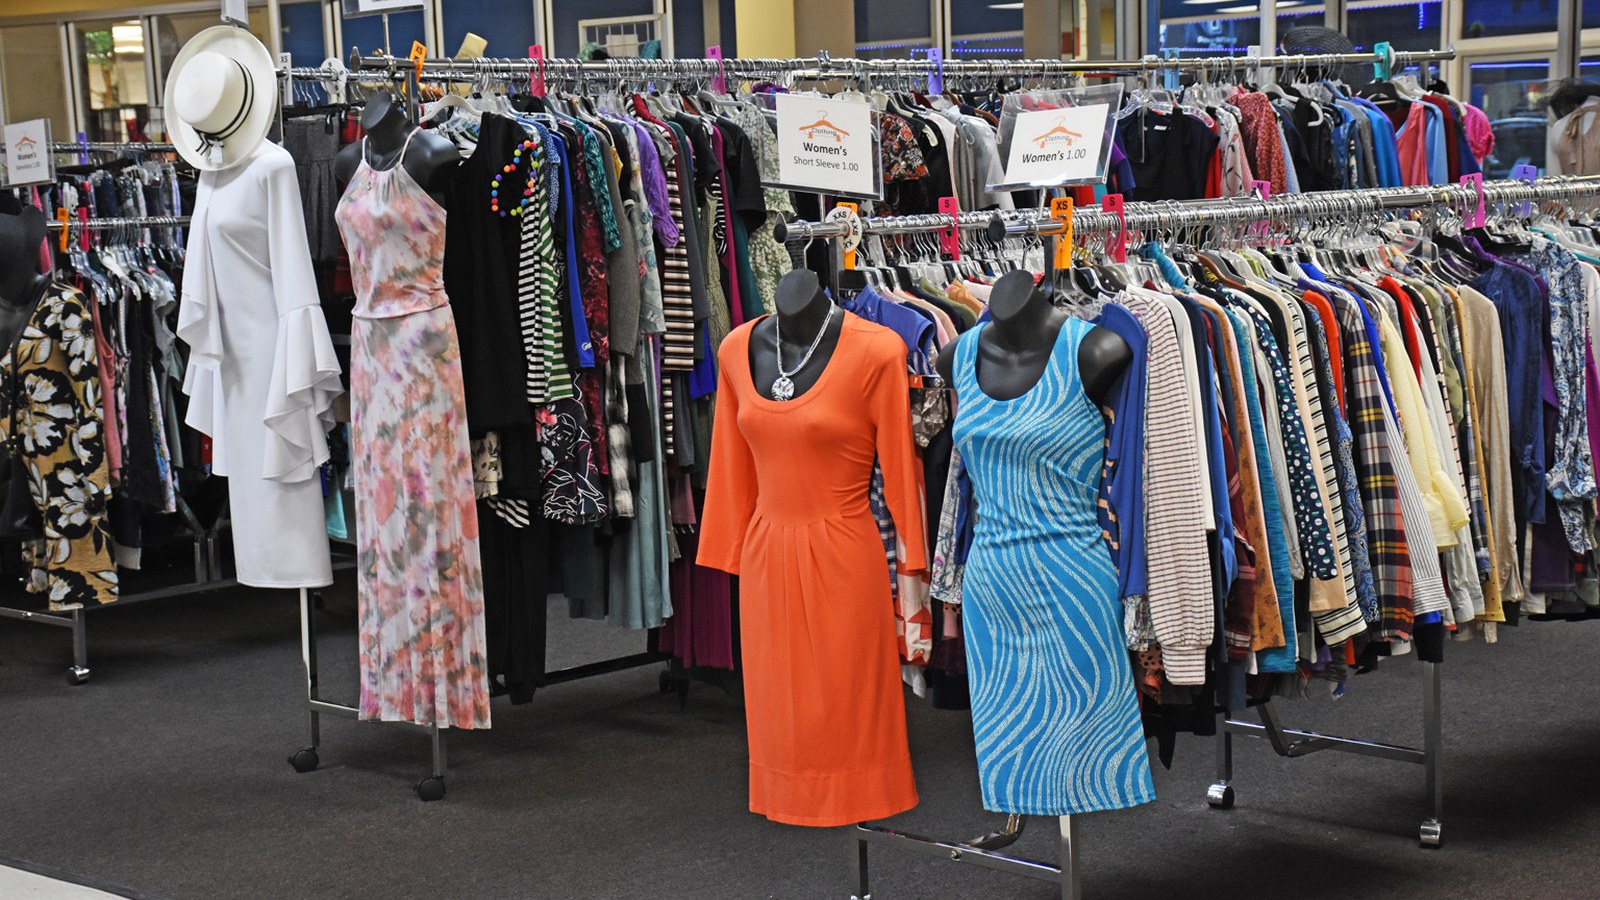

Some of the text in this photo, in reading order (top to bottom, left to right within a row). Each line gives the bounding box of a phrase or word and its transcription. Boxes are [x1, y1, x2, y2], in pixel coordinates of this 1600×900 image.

[415, 44, 424, 55] XS
[533, 46, 538, 55] S
[710, 47, 716, 55] M
[932, 49, 937, 57] L
[280, 55, 288, 63] XS
[811, 127, 837, 136] Clothing
[1044, 135, 1069, 143] Clothing
[803, 142, 847, 156] Women's
[1022, 148, 1086, 163] Women's 1.00
[793, 155, 859, 172] Short Sleeve 1.00
[1523, 166, 1529, 175] L
[944, 199, 950, 208] S
[1056, 200, 1068, 210] XS
[1109, 196, 1115, 206] S
[832, 211, 847, 221] XXS
[850, 218, 859, 236] XXS
[842, 238, 854, 249] XX
